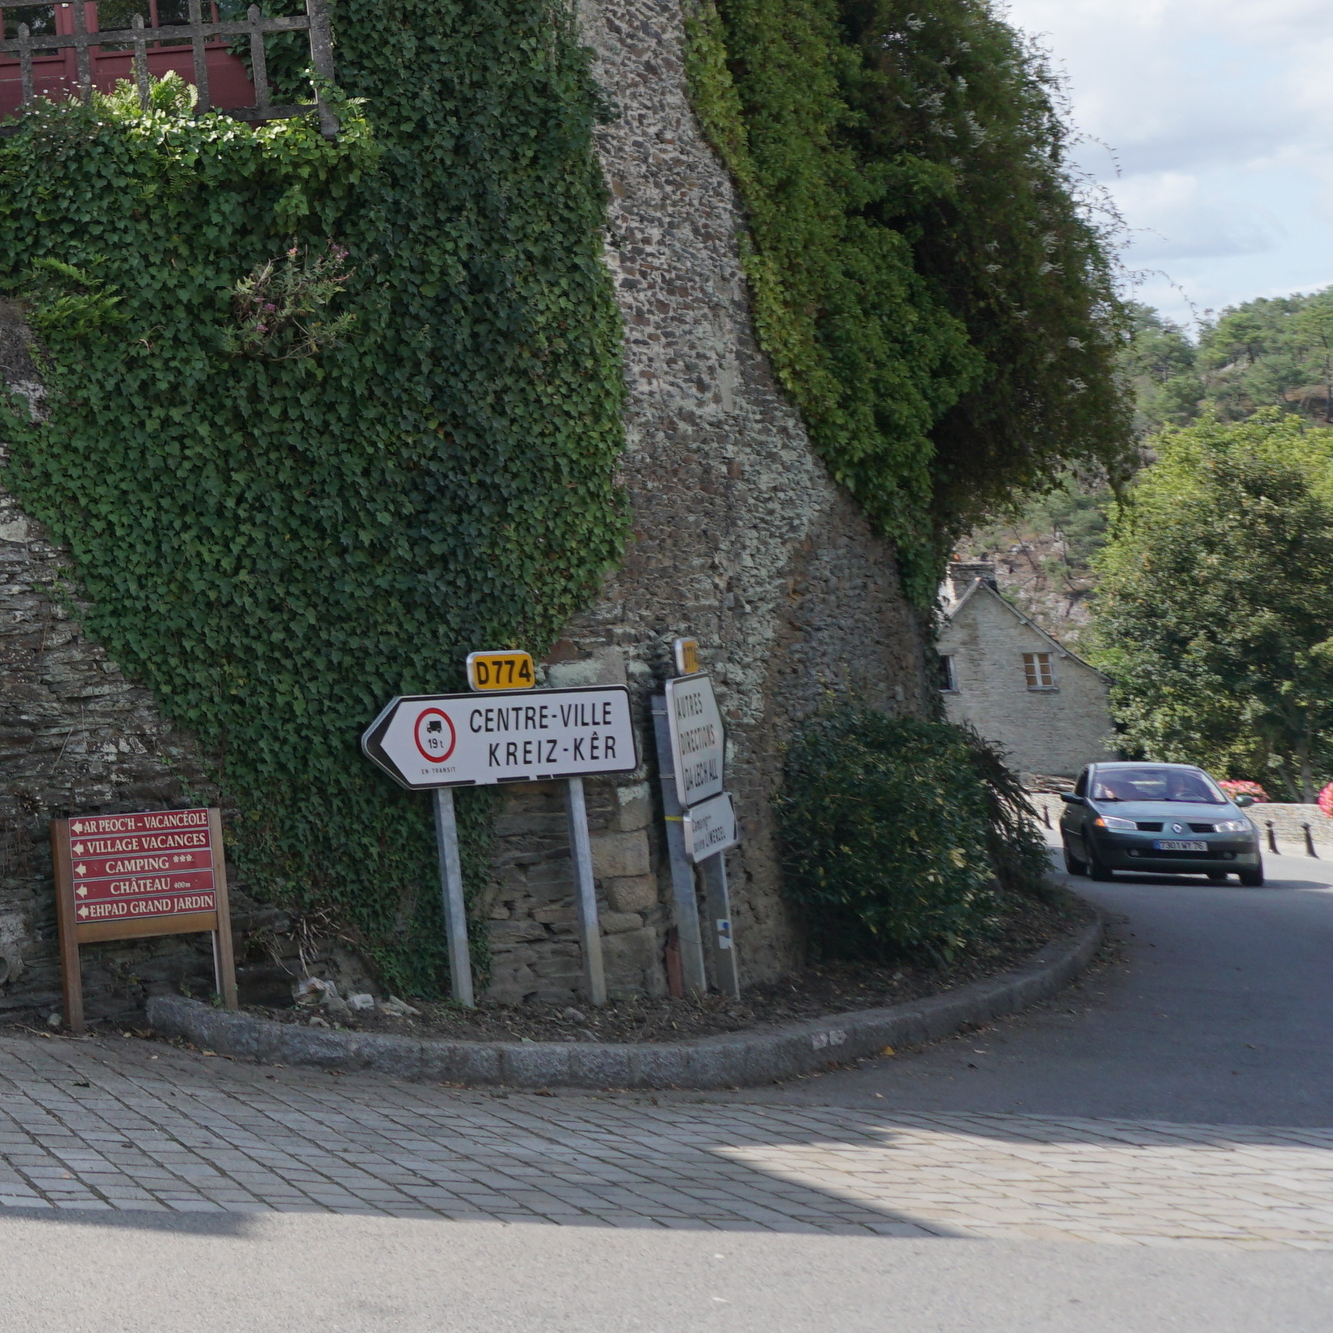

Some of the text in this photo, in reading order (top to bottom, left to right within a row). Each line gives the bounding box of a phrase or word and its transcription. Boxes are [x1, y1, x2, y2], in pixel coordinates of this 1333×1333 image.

[476, 659, 532, 686] D774
[469, 701, 612, 733] CENTRE-VILLE
[676, 692, 703, 720] AUTRES
[427, 738, 438, 749] 19
[488, 731, 617, 767] KREIZ-KÊR
[679, 724, 716, 756] DIRECTIONS
[431, 766, 457, 774] TRANSIT
[84, 820, 98, 833] AR
[99, 817, 136, 832] PEOC'H
[144, 811, 207, 829] VACANCÉOLE
[87, 832, 206, 854] VILLAGE VACANCES
[105, 856, 170, 874] CAMPING
[110, 877, 171, 895] CHÂTEAU
[90, 895, 214, 918] EHPAD GRAND JARDIN
